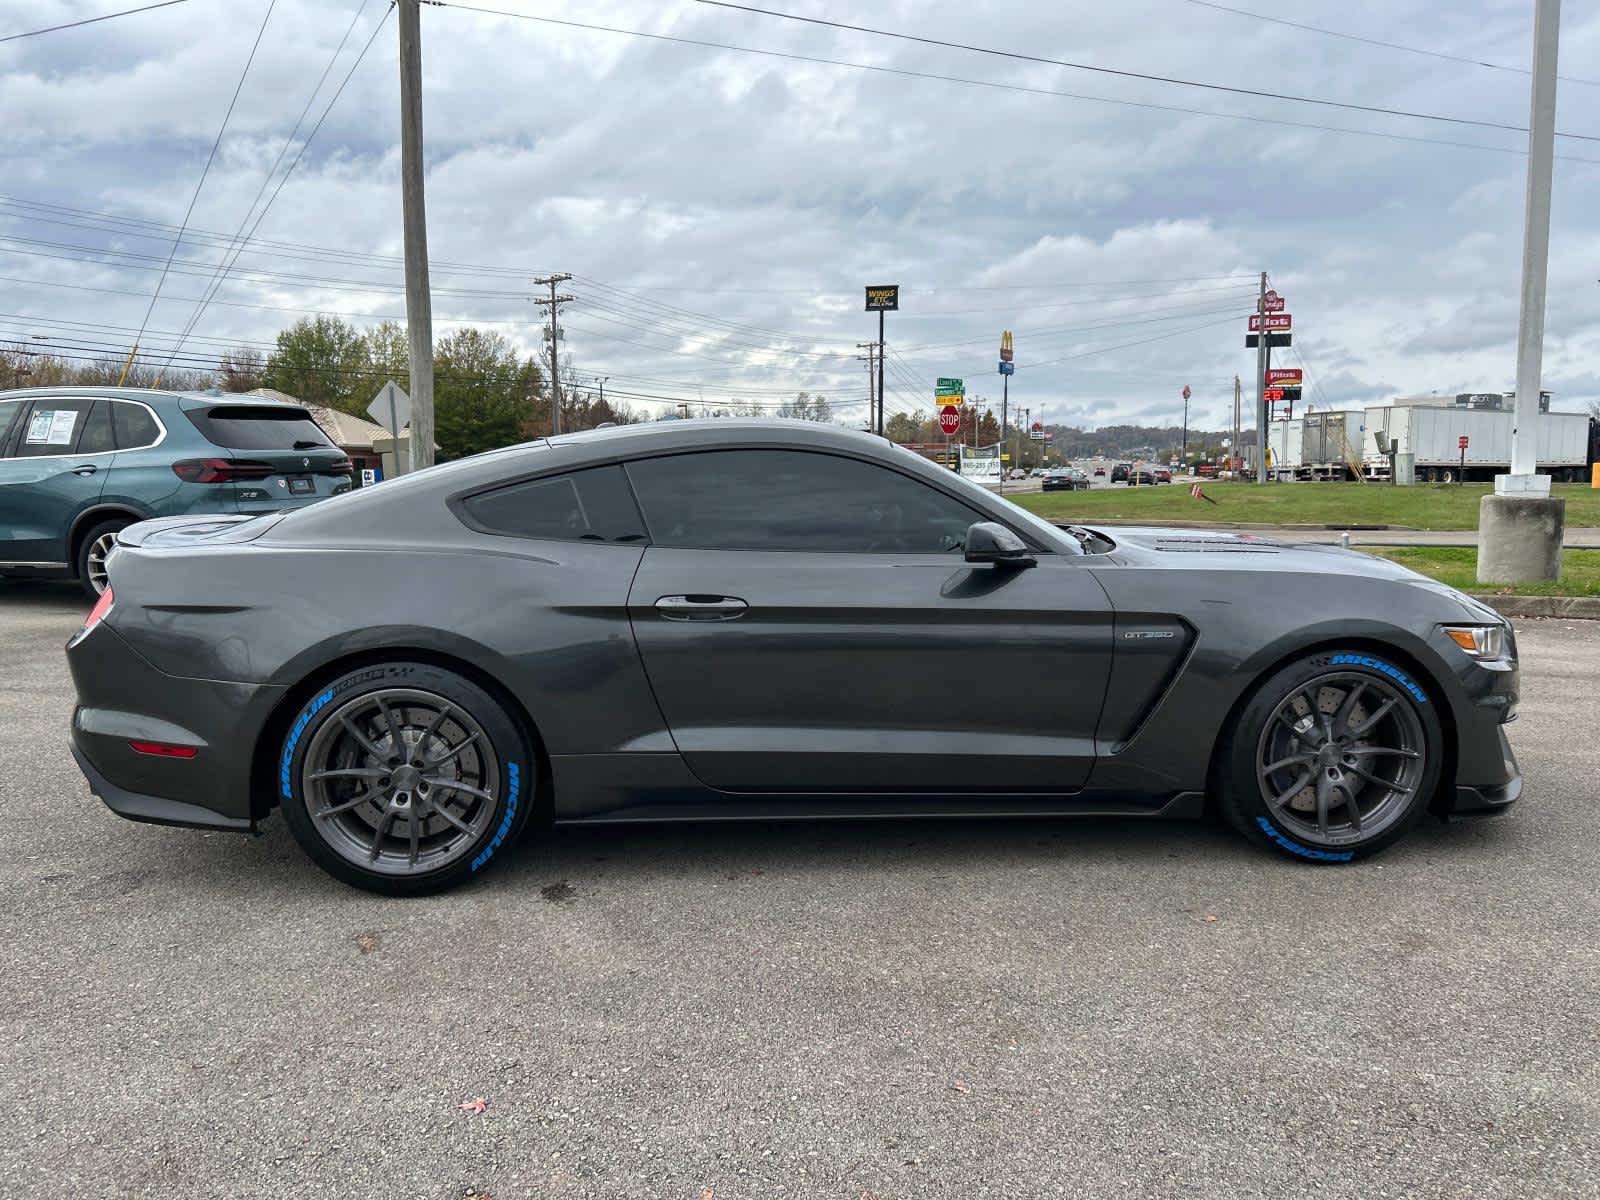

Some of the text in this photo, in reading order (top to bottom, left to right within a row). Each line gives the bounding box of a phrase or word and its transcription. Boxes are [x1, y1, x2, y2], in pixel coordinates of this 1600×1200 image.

[1251, 318, 1289, 329] Plot
[940, 414, 959, 426] STOP
[1330, 654, 1427, 704] MICHELIN
[280, 687, 334, 800] MICHELIN
[470, 760, 520, 872] MICHELIN
[1256, 816, 1355, 861] MICHELIN
